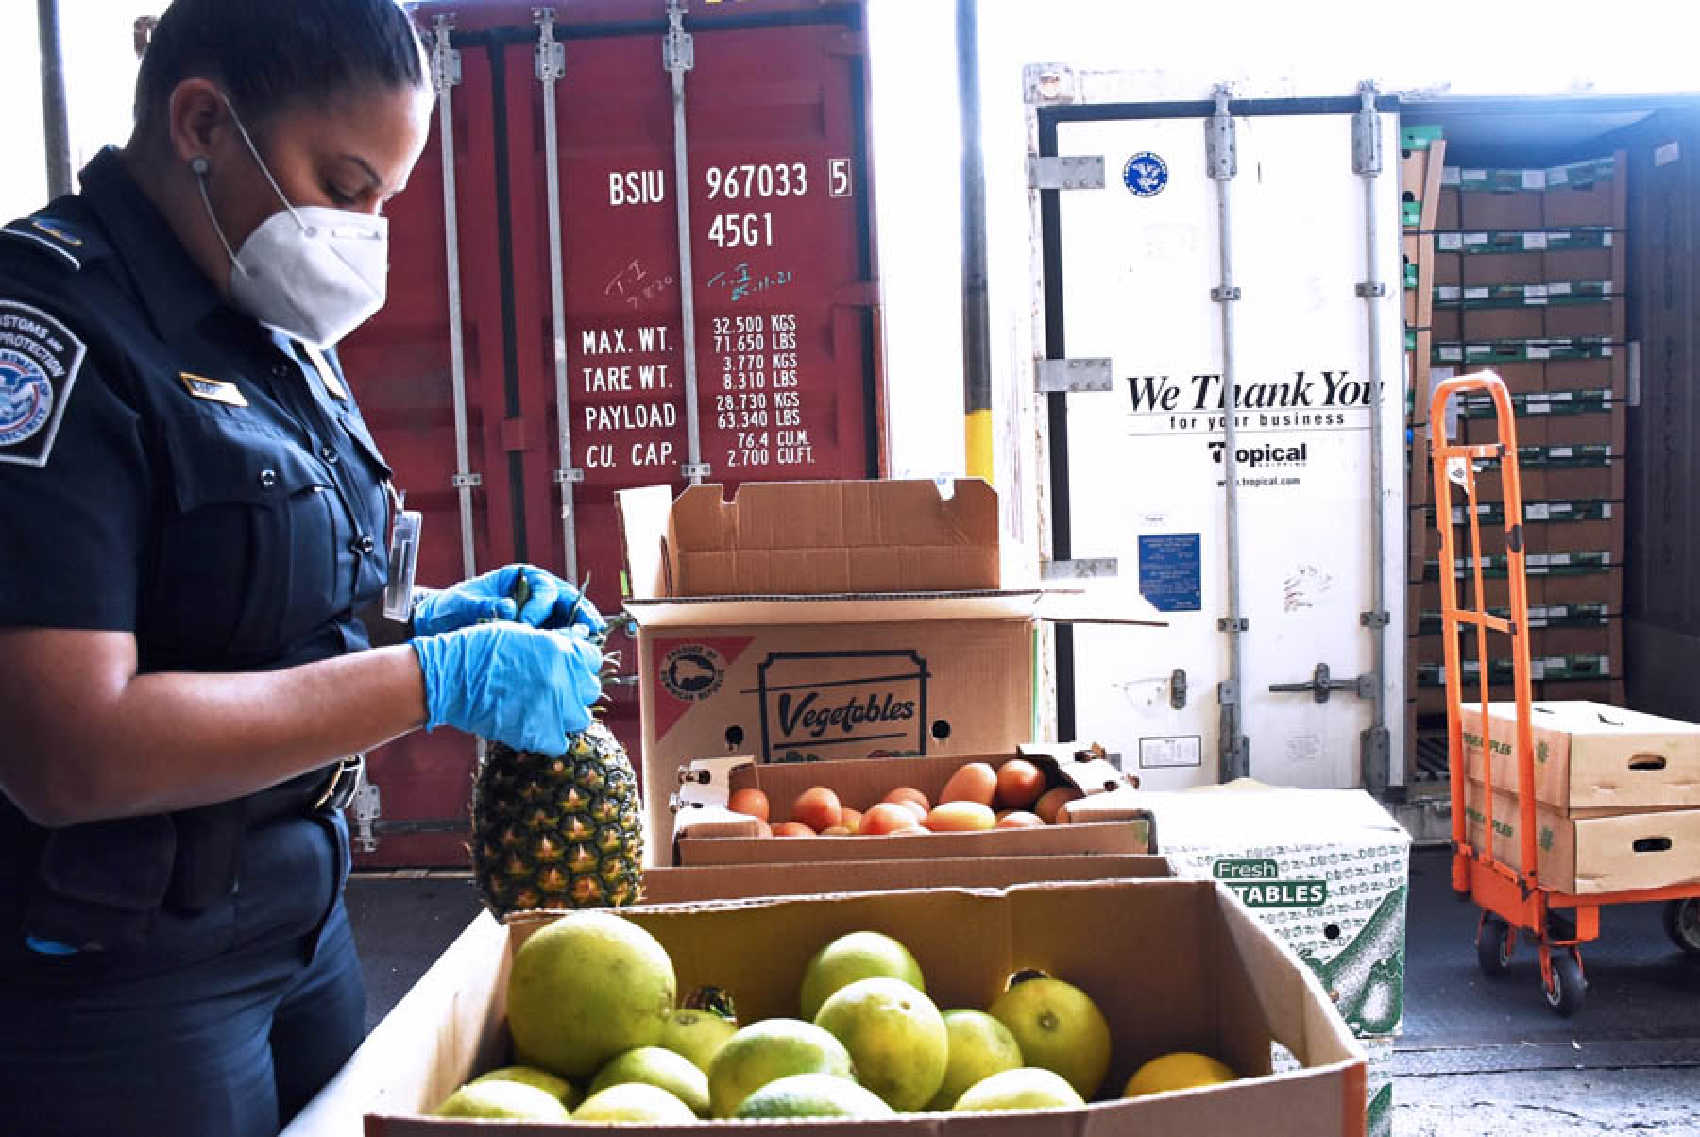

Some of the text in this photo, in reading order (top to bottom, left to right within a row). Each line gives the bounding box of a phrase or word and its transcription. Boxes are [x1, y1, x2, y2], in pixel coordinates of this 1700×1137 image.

[609, 160, 848, 206] BSIU 967033 5
[707, 212, 774, 248] 45G1
[771, 314, 797, 332] KGS
[582, 326, 674, 355] MAX. WT.
[772, 332, 797, 350] LBS
[772, 352, 798, 369] KGS
[583, 364, 674, 392] TARE WT.
[774, 369, 798, 388] LBS
[774, 391, 800, 409] KGS
[1126, 376, 1181, 413] We
[585, 402, 677, 431] PAYLOAD
[776, 409, 801, 426] LBS
[1169, 415, 1198, 430] for
[1259, 410, 1345, 428] business
[586, 442, 678, 468] CU. CAP.
[1207, 441, 1308, 468] Topical
[777, 692, 915, 738] Vegetables
[1217, 860, 1277, 878] Fresh
